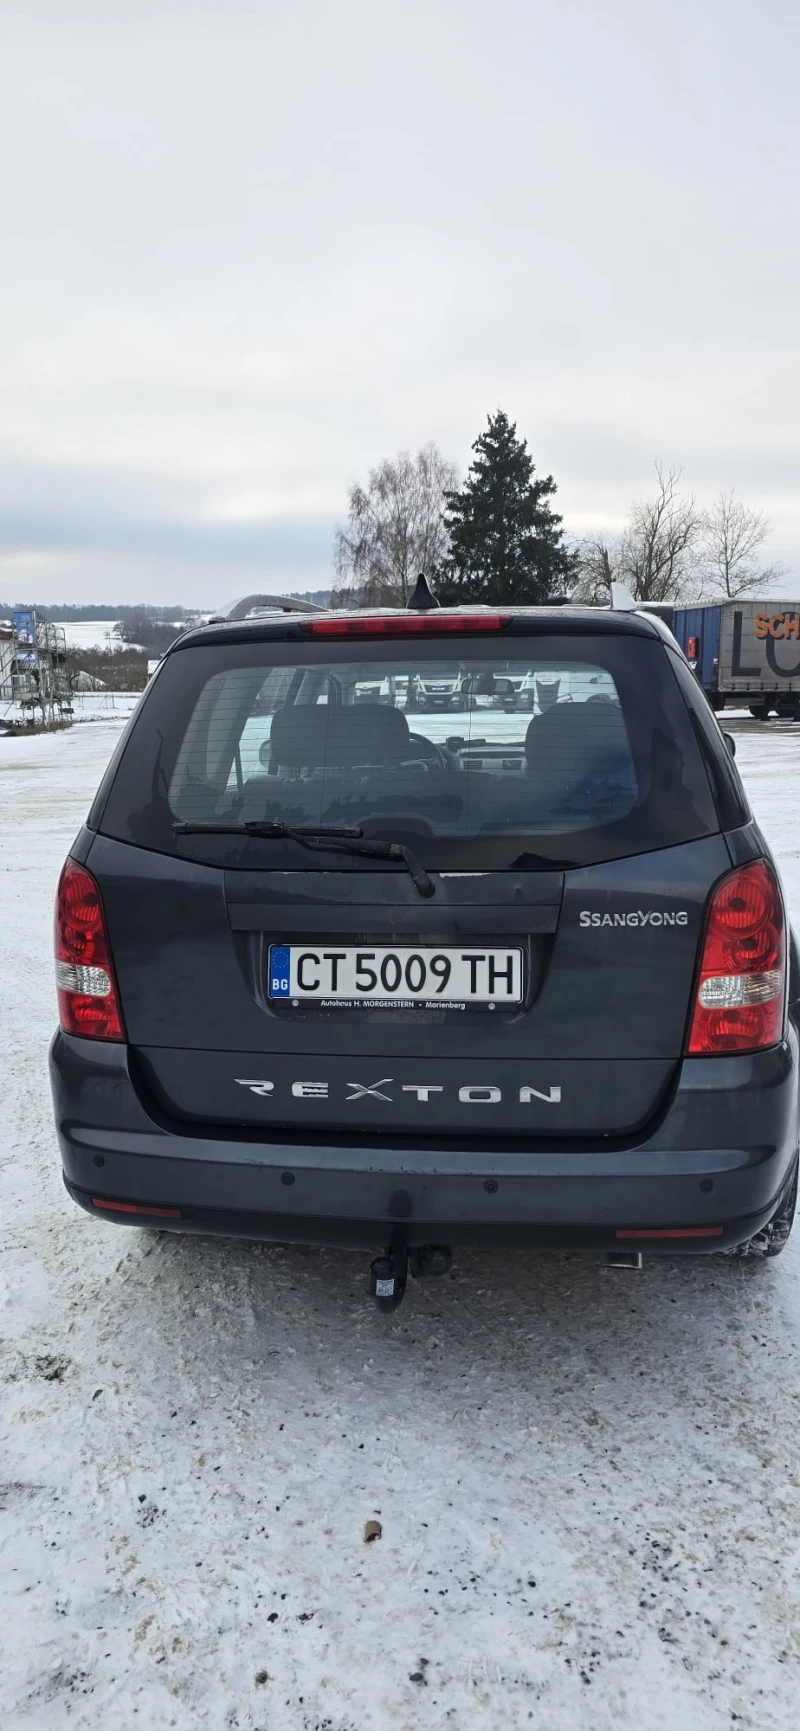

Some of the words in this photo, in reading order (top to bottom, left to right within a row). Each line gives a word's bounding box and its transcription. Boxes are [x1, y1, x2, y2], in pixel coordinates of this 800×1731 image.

[753, 612, 800, 640] SCH
[272, 979, 288, 990] BG
[297, 953, 346, 991] CT
[356, 954, 451, 993] 5009
[461, 955, 513, 995] TH
[362, 1001, 414, 1009] MORGENSTERN
[426, 1002, 466, 1010] Marienberg
[234, 1078, 562, 1103] REXTON
